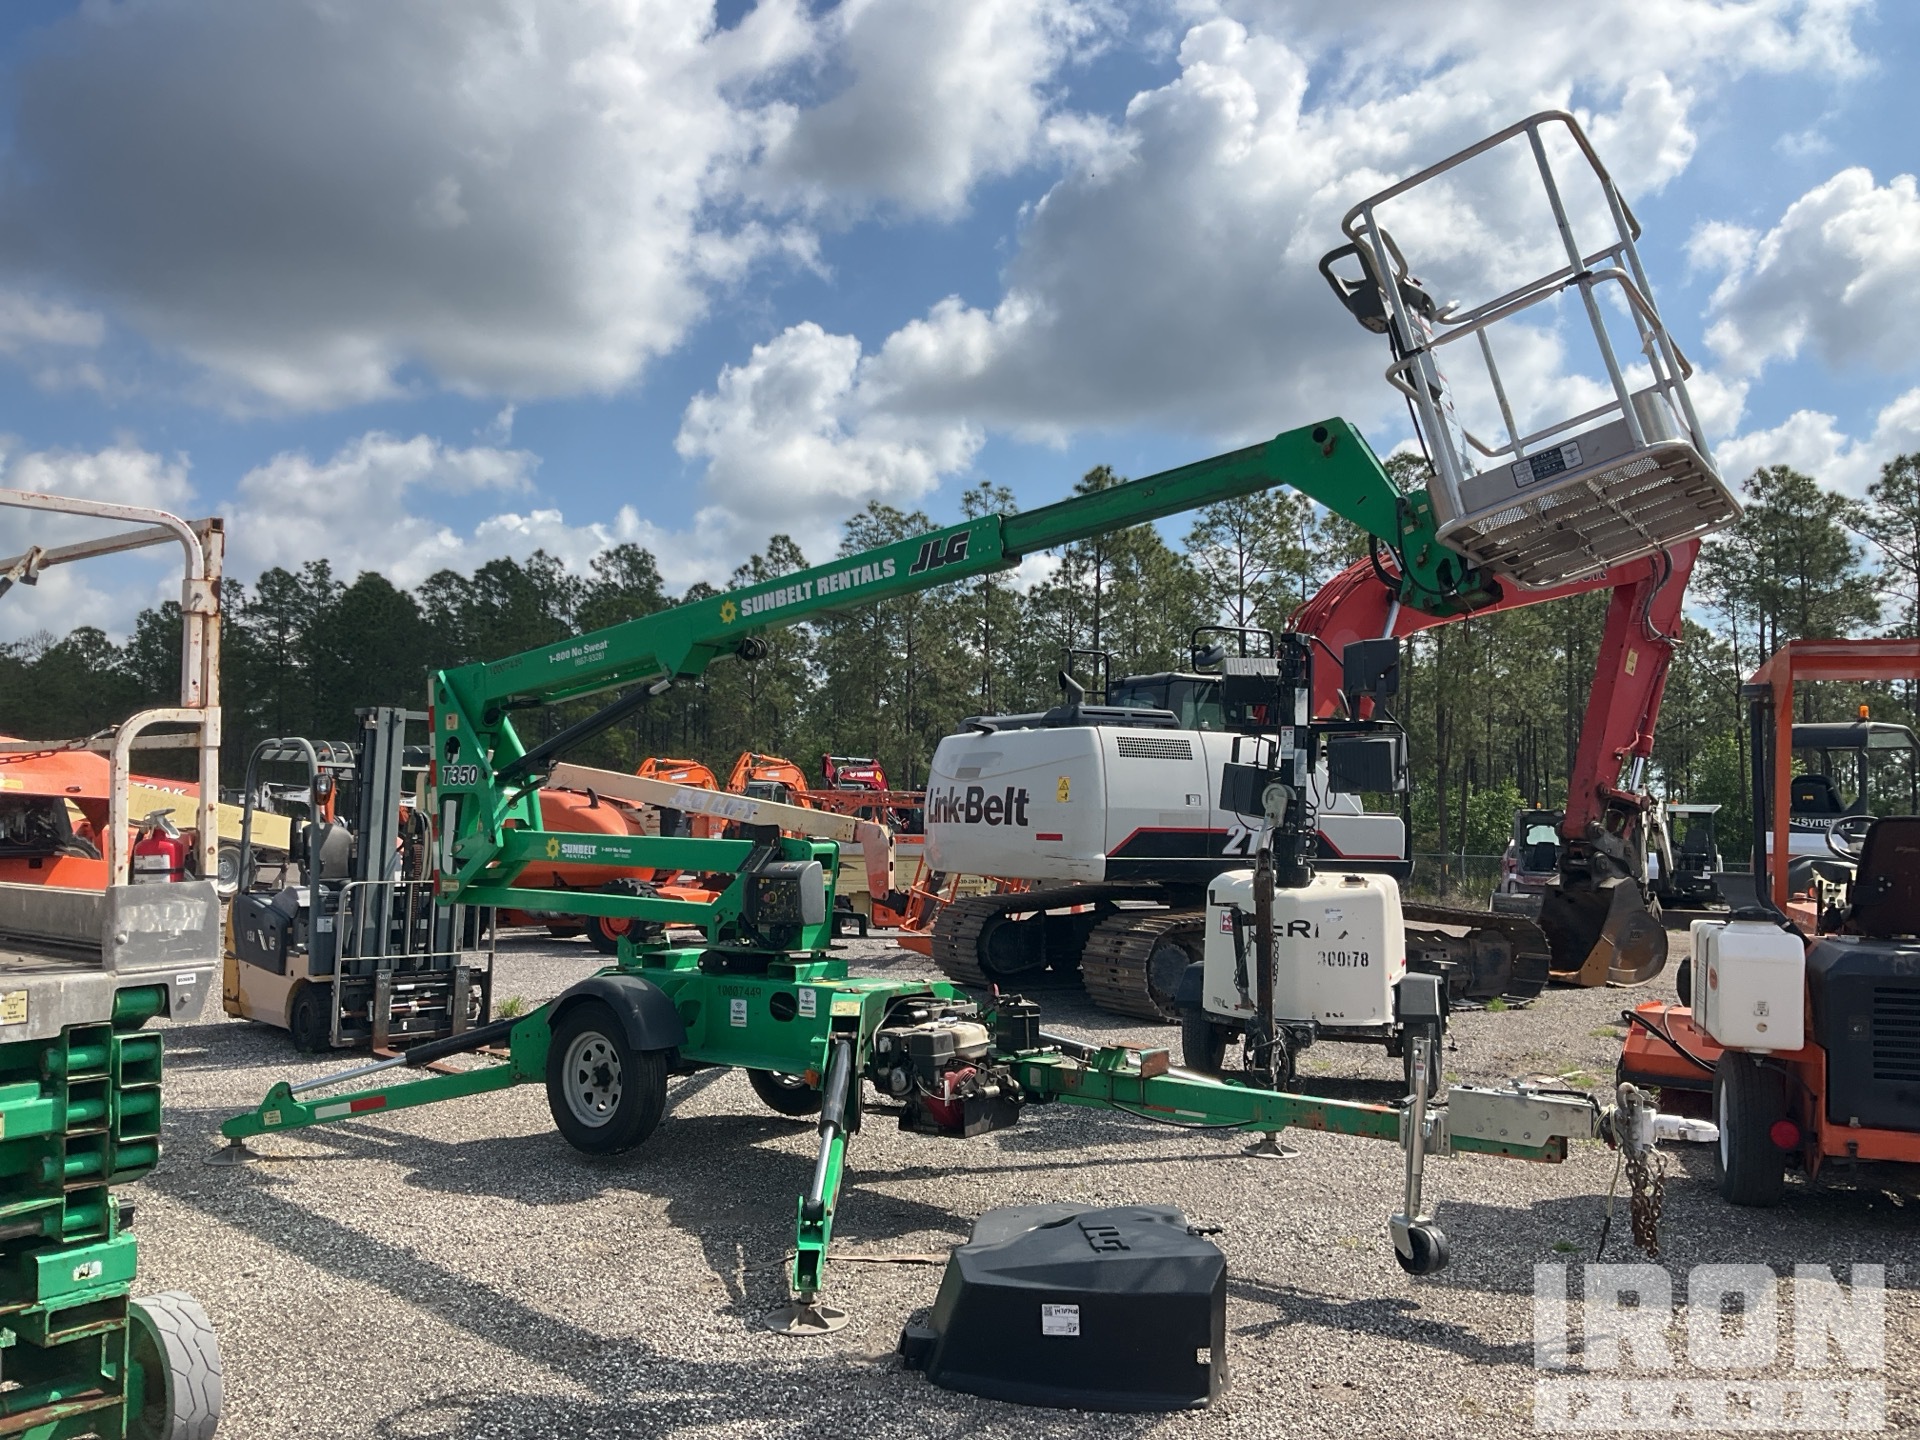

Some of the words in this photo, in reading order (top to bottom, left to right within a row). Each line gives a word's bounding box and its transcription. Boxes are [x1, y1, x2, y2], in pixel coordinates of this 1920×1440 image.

[908, 530, 971, 576] JLG
[741, 581, 812, 617] SUNBELT
[817, 558, 896, 596] RENTALS
[549, 650, 571, 664] 1-800
[571, 646, 582, 657] No
[583, 640, 609, 653] Sweat
[442, 765, 478, 786] T350
[928, 785, 1030, 827] Link-Belt
[561, 843, 597, 855] SUNBELT
[717, 985, 762, 997] 10007449
